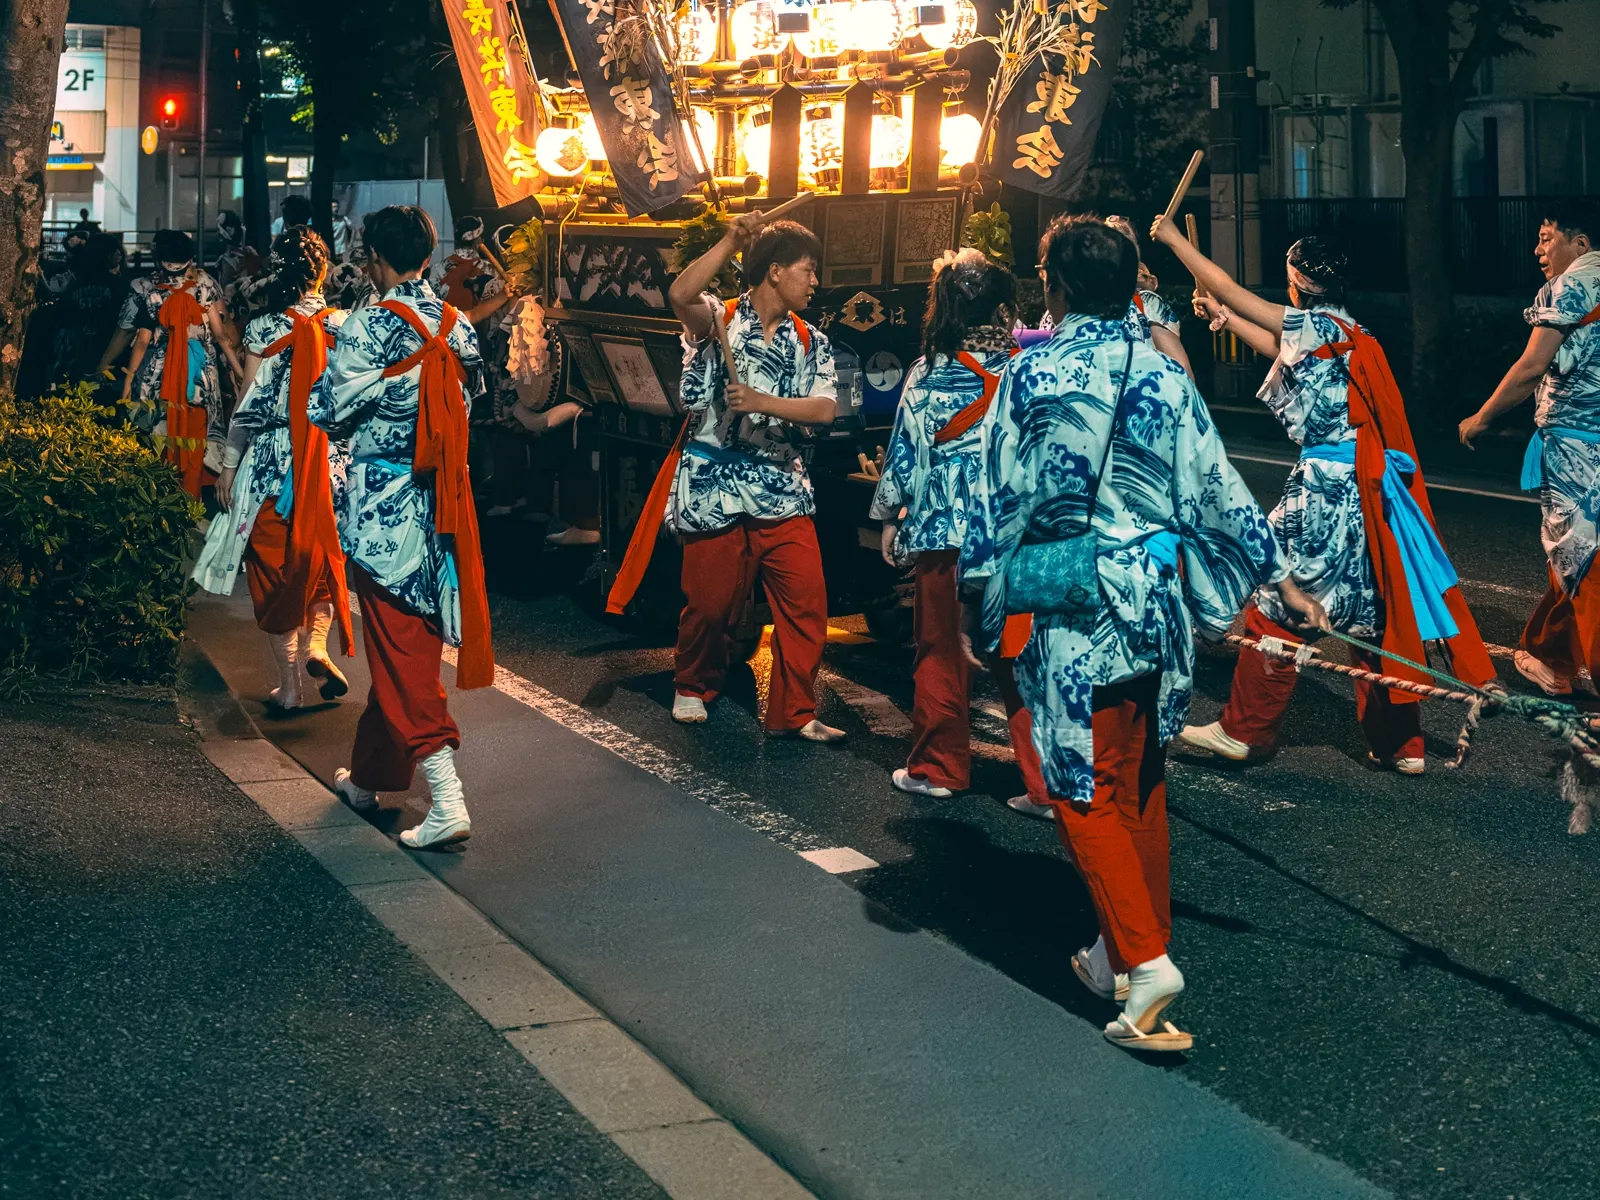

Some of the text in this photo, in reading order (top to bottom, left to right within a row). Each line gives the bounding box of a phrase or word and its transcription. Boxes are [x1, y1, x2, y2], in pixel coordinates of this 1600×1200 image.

[64, 69, 94, 91] 2F
[889, 306, 907, 326] は
[1200, 463, 1224, 510] 長浜
